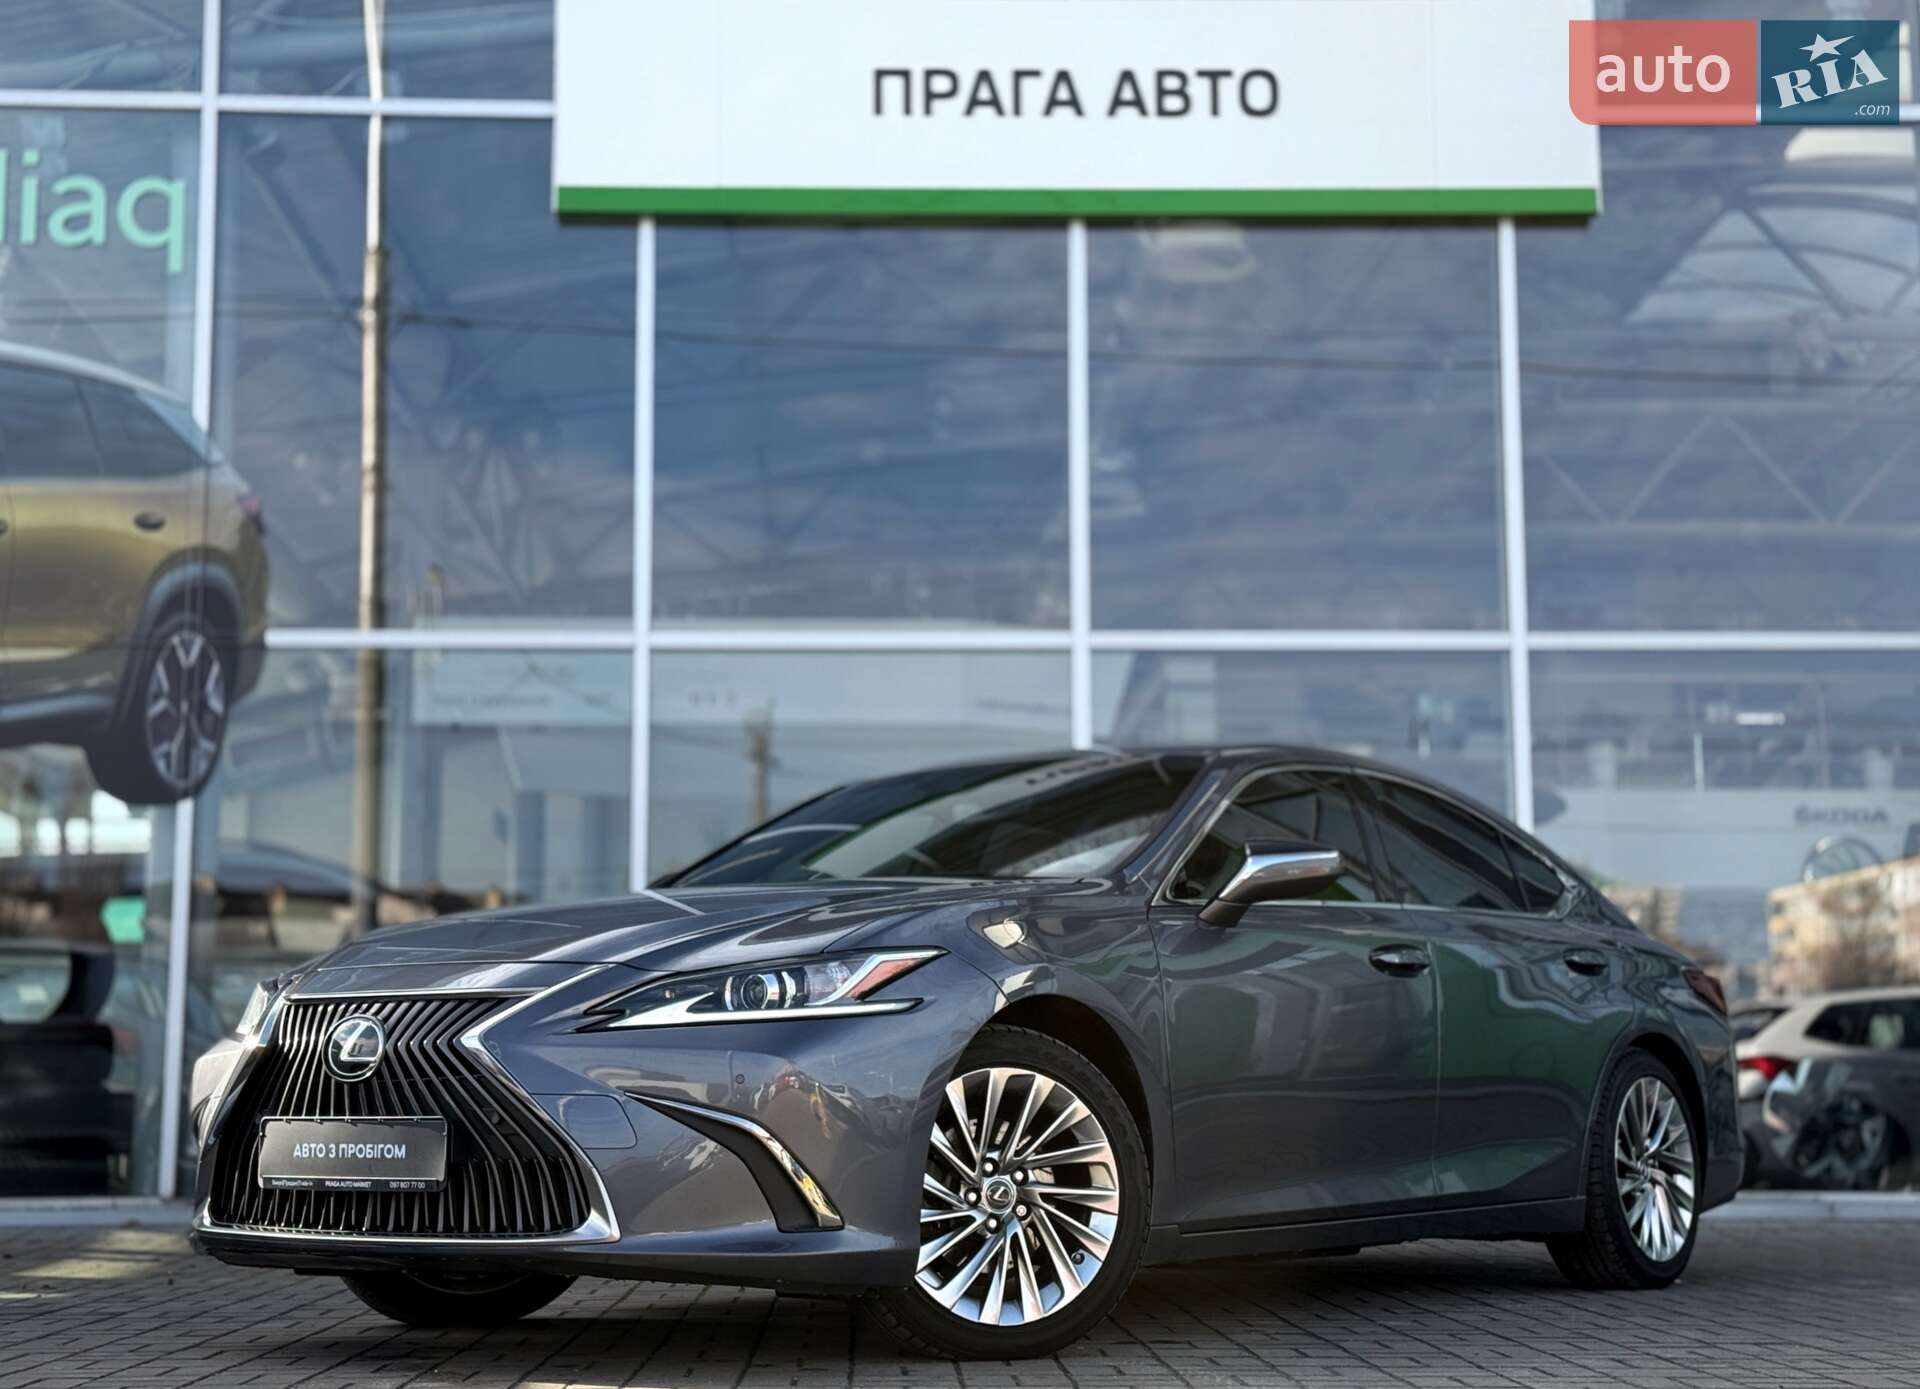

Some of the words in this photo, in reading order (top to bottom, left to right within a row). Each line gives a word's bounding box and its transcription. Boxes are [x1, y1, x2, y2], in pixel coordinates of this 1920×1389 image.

[873, 69, 1085, 118] ПРАГА
[1107, 69, 1280, 118] АВТО
[0, 148, 186, 273] iaq
[293, 1143, 326, 1158] АВТО
[338, 1143, 406, 1159] ПРОБІГОМ
